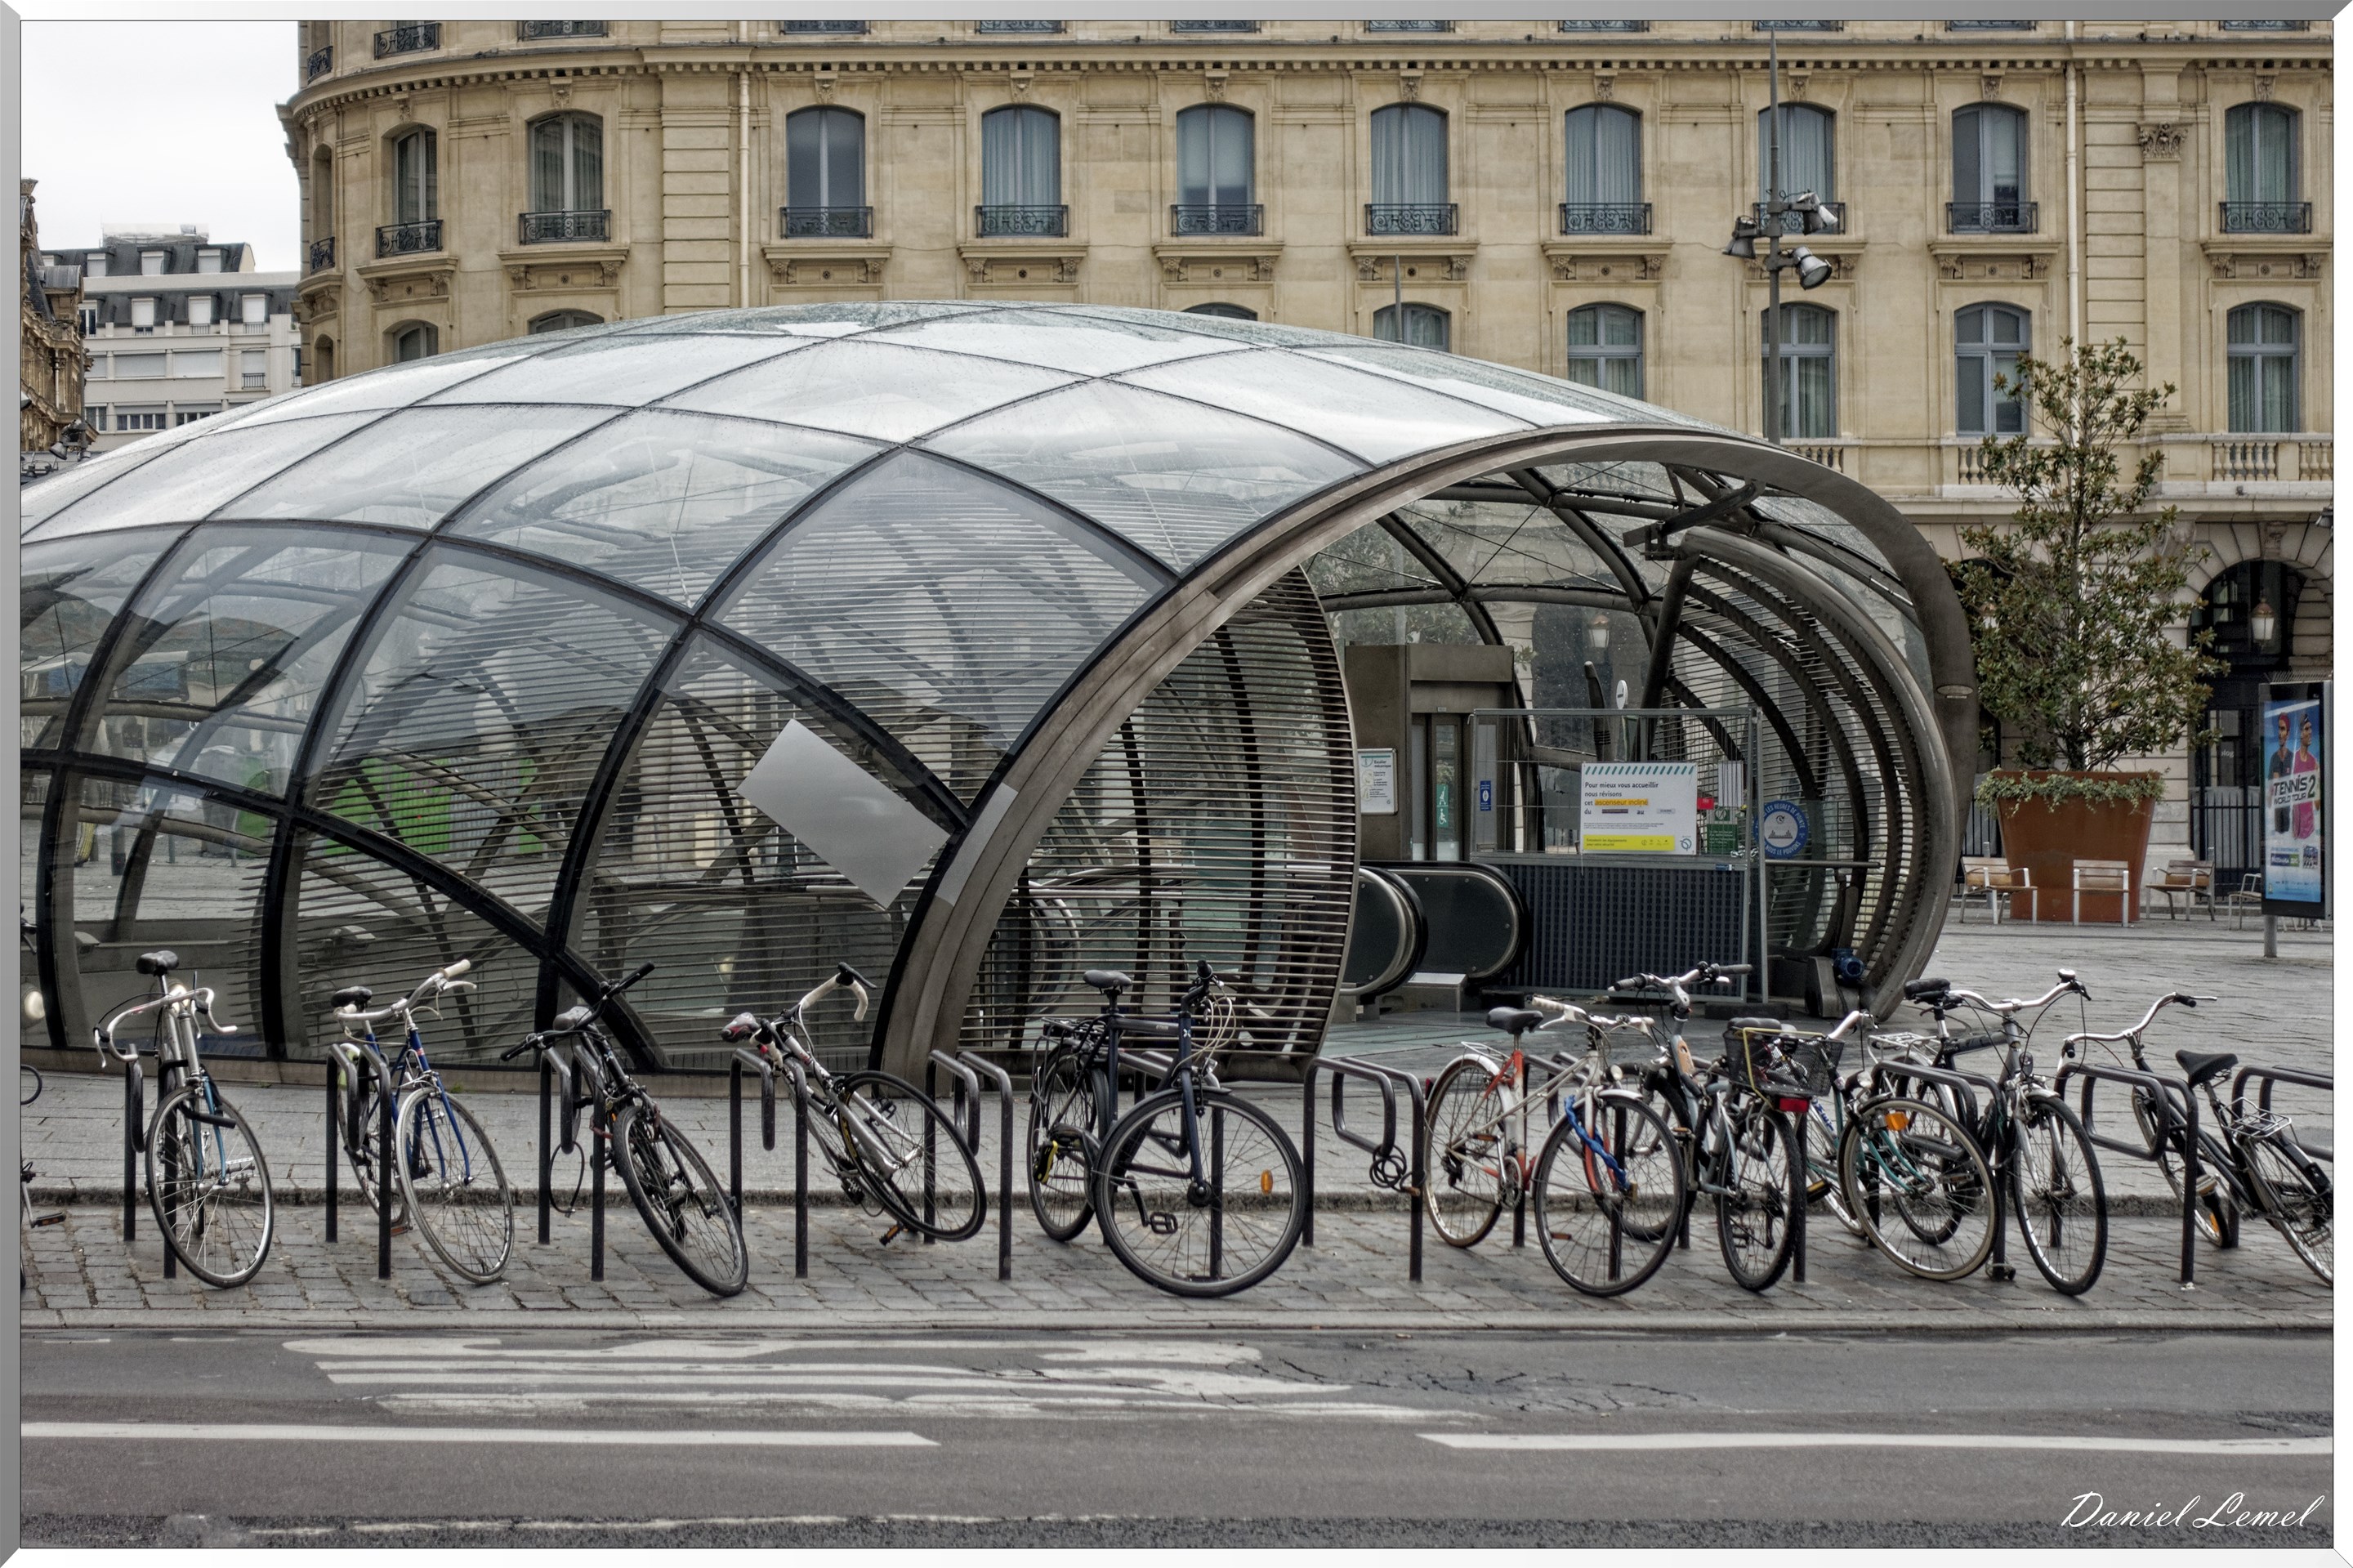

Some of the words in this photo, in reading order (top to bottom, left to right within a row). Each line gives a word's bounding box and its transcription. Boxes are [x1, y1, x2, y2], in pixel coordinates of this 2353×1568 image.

[2307, 774, 2316, 798] 2
[1628, 798, 1648, 806] incliné
[2274, 795, 2291, 805] WORLD
[2292, 793, 2306, 802] TOUR
[1765, 804, 1775, 813] LES
[1794, 812, 1806, 828] POINTE
